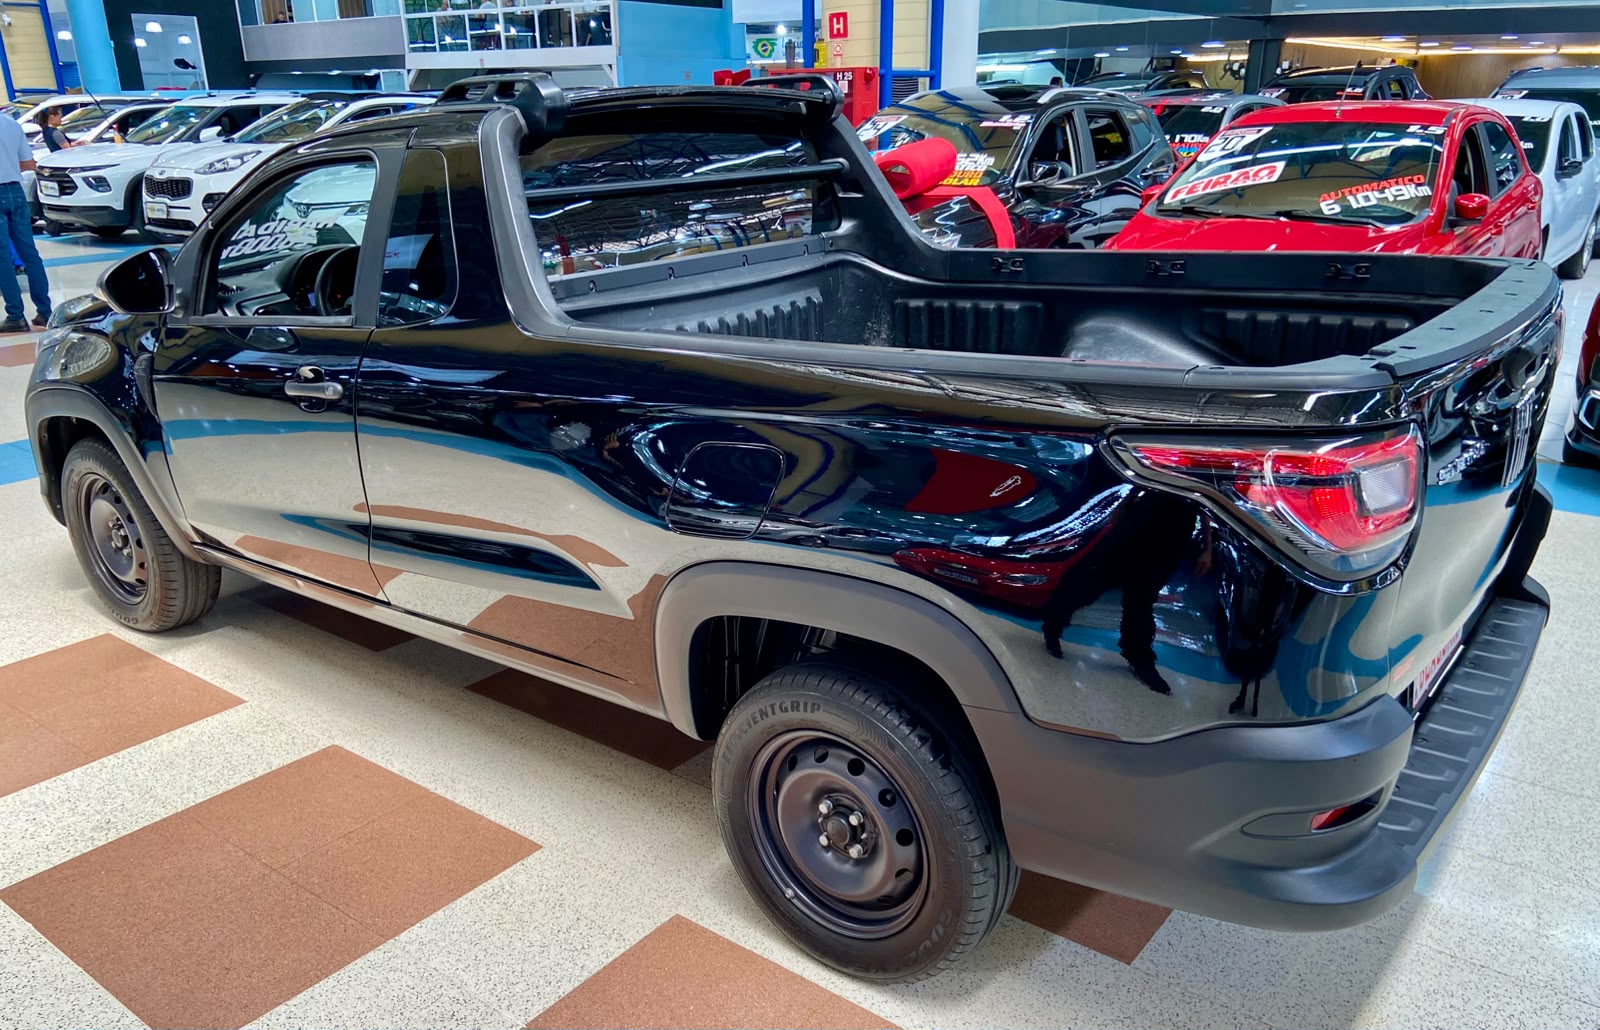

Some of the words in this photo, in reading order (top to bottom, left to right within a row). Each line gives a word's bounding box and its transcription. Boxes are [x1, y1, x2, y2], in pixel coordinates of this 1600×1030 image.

[833, 16, 844, 34] H
[844, 72, 853, 81] 25
[1318, 174, 1425, 202] AUTOMATICO
